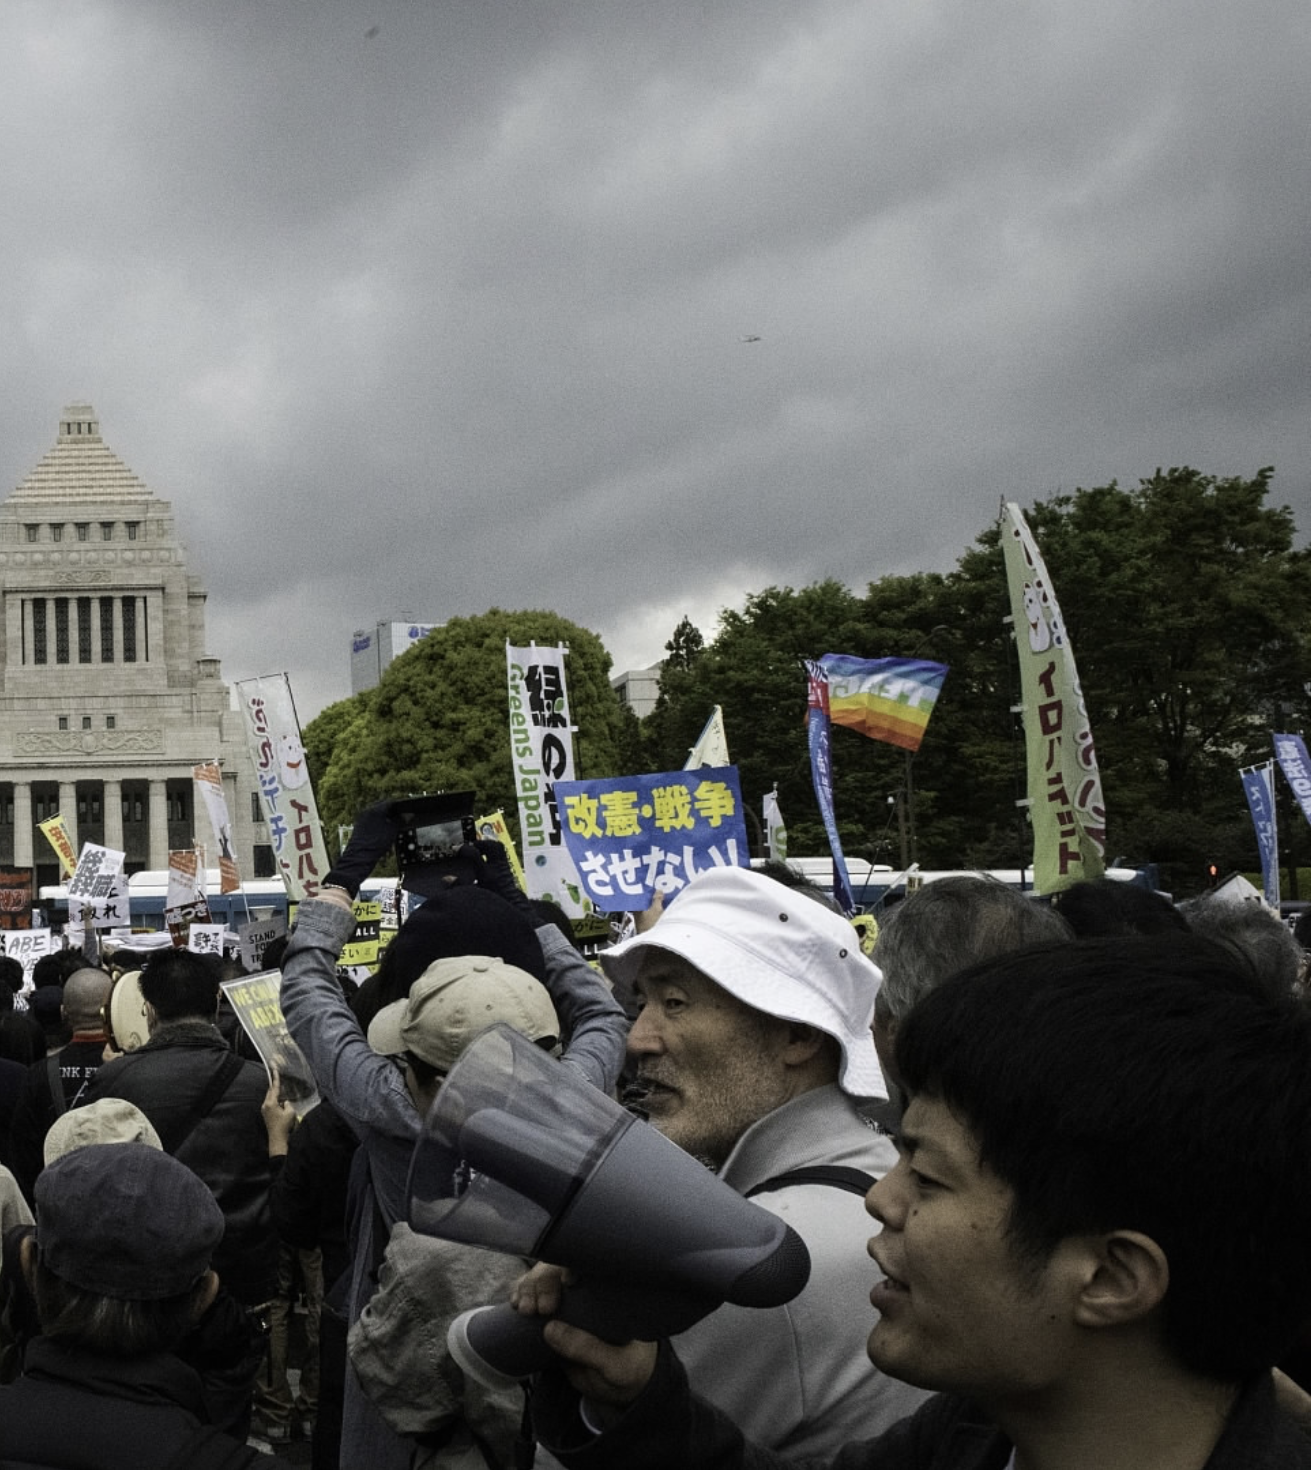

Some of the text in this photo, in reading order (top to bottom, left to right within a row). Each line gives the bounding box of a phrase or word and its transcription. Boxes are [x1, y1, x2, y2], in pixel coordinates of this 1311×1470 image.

[510, 663, 546, 847] Greens Japan
[563, 780, 735, 839] 改憲・戦争
[248, 930, 276, 944] STAND
[356, 926, 376, 937] ALL
[8, 934, 47, 955] ABE
